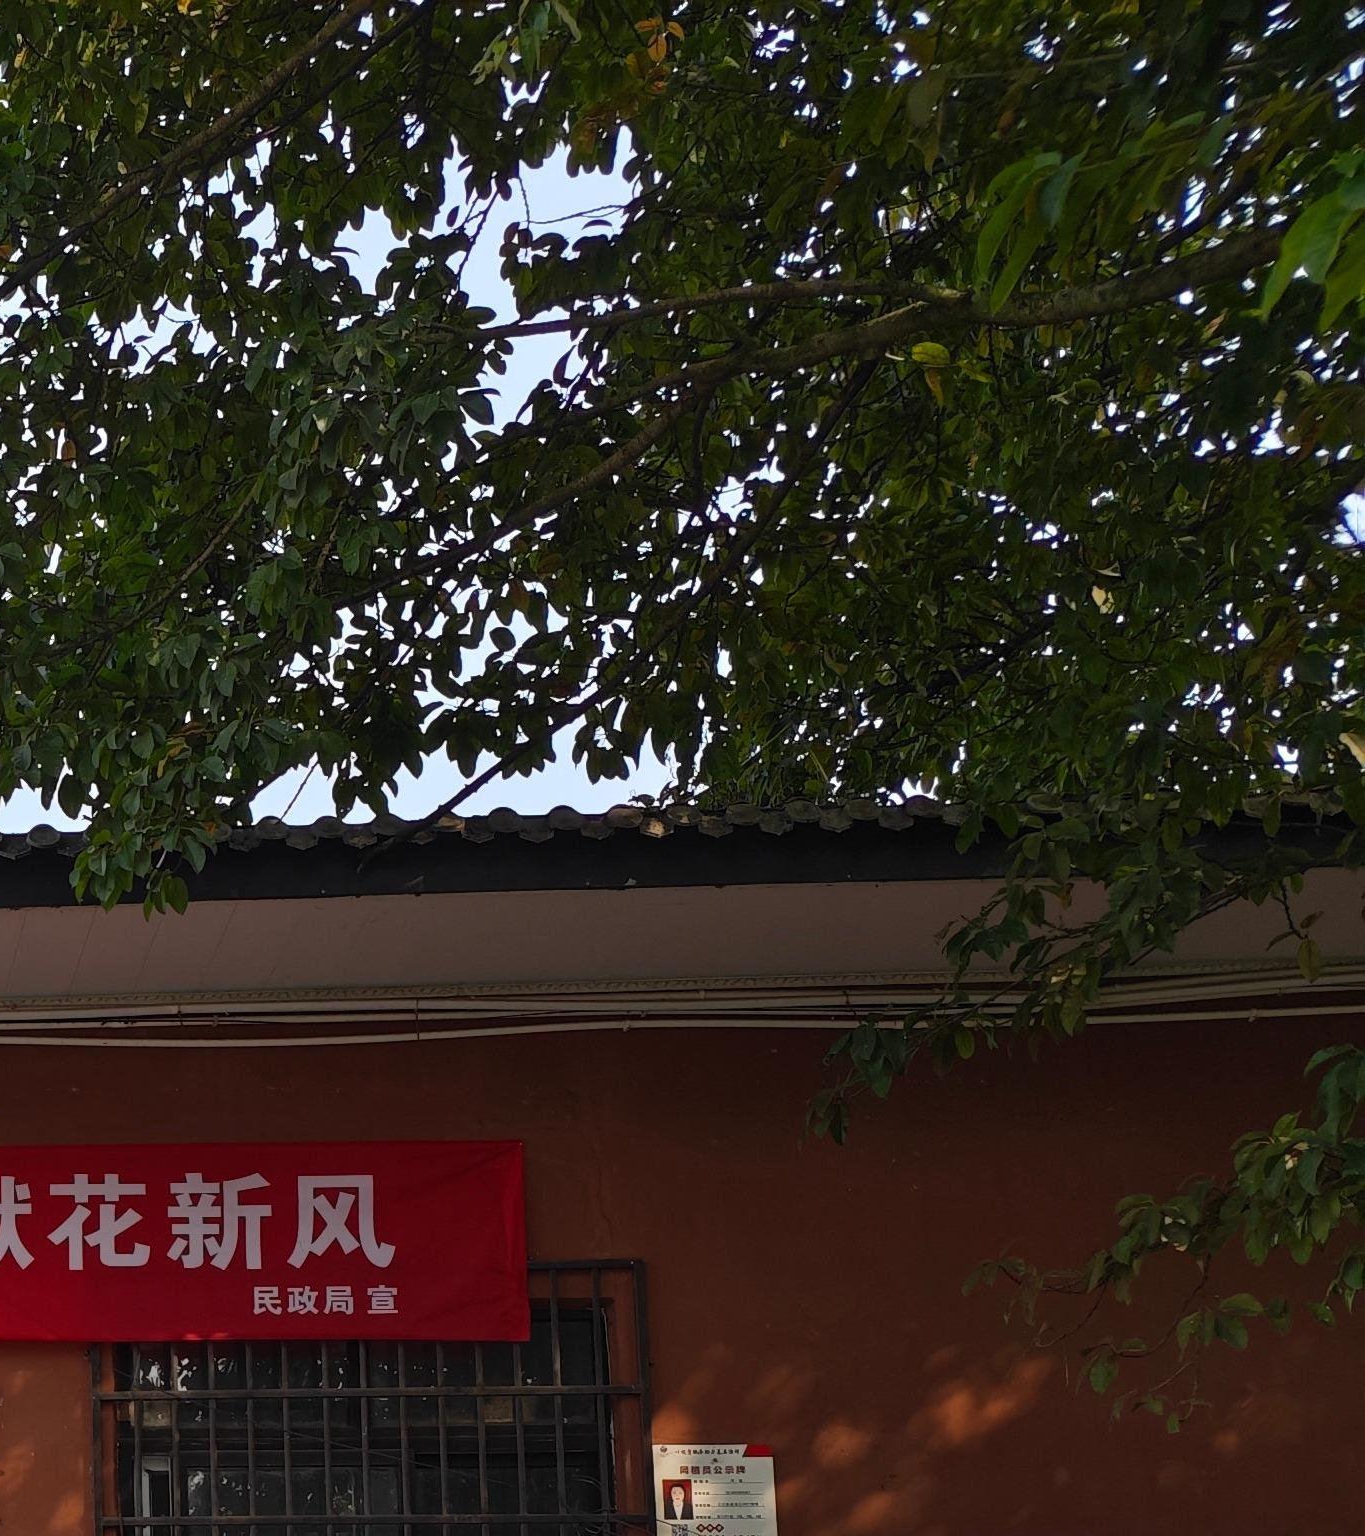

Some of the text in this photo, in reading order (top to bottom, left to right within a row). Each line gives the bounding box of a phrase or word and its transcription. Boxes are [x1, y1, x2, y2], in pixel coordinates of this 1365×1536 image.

[253, 1284, 399, 1315] 民政局 宣
